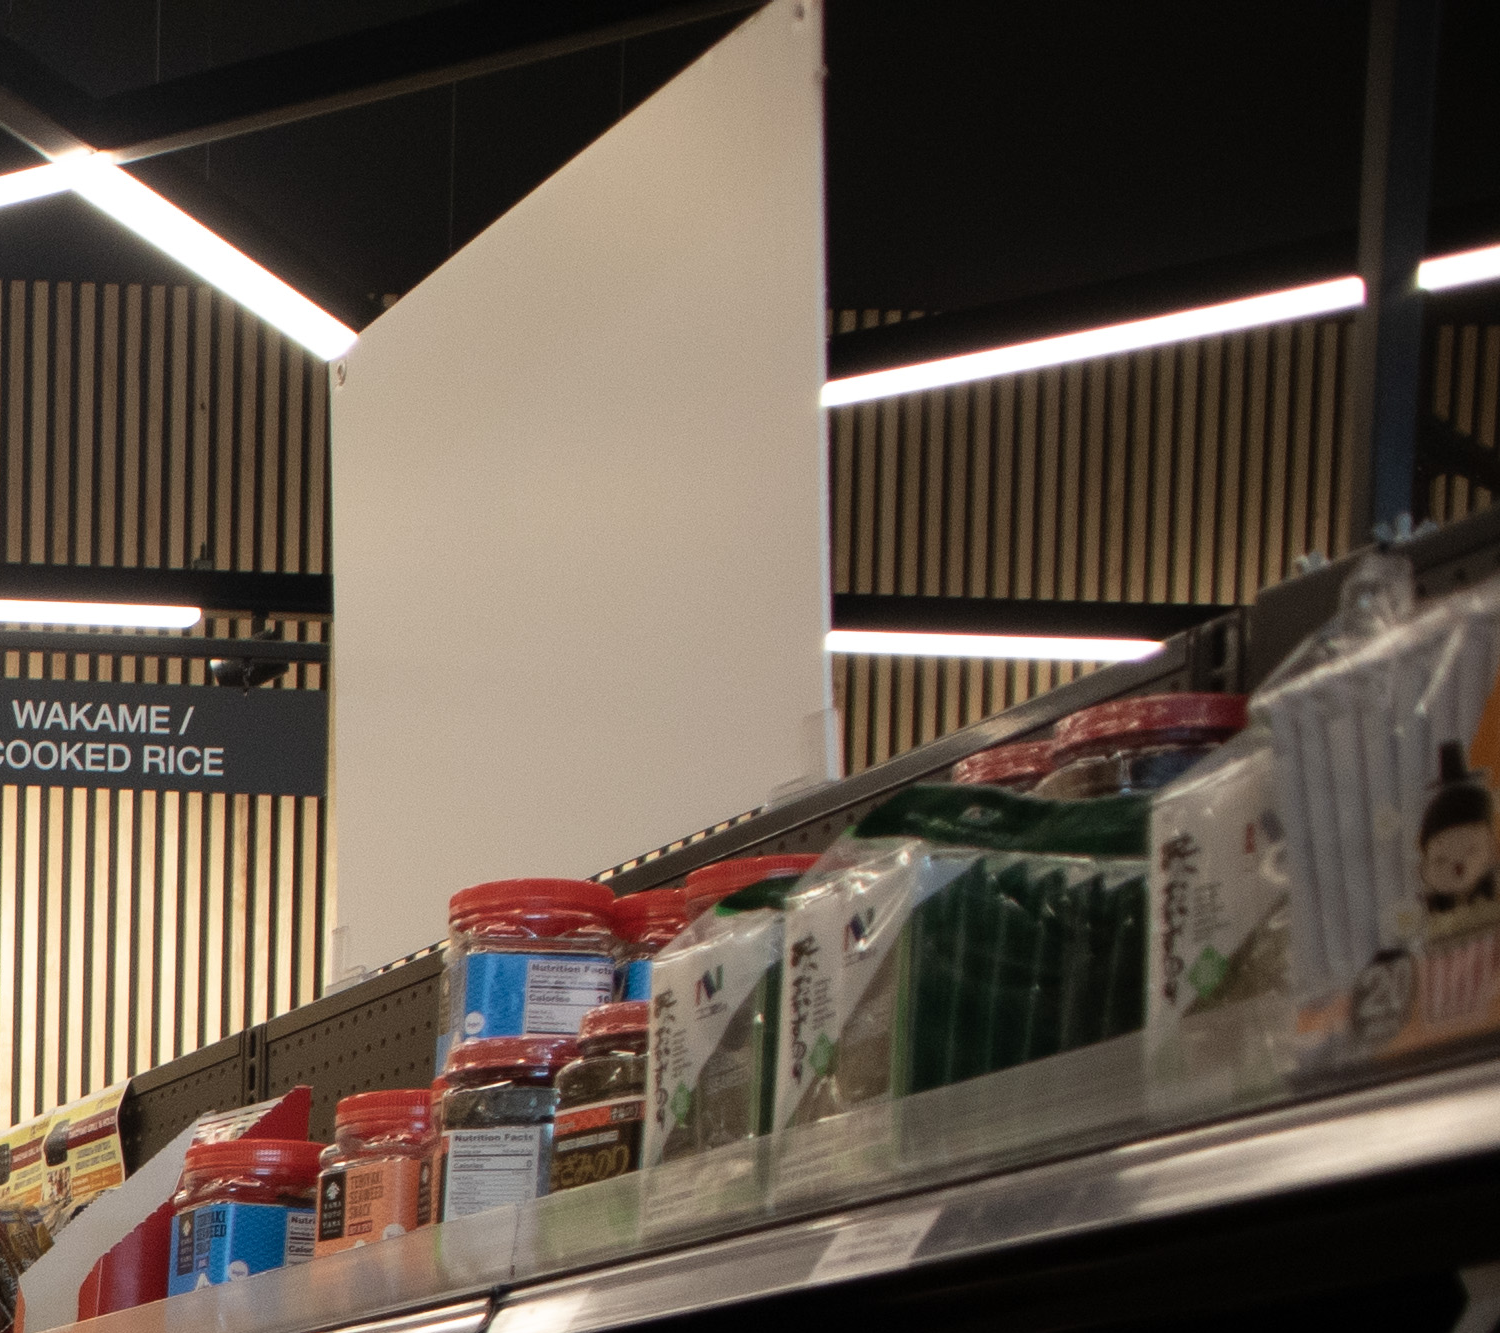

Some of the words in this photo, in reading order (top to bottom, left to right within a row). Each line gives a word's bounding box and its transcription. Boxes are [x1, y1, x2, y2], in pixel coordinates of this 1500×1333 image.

[11, 700, 170, 734] WAKAME
[178, 706, 195, 736] /
[142, 744, 224, 776] RICE
[454, 1134, 501, 1143] Nutrition
[504, 1133, 534, 1142] Facts
[290, 1216, 316, 1225] Nutri
[288, 1245, 314, 1254] Calor
